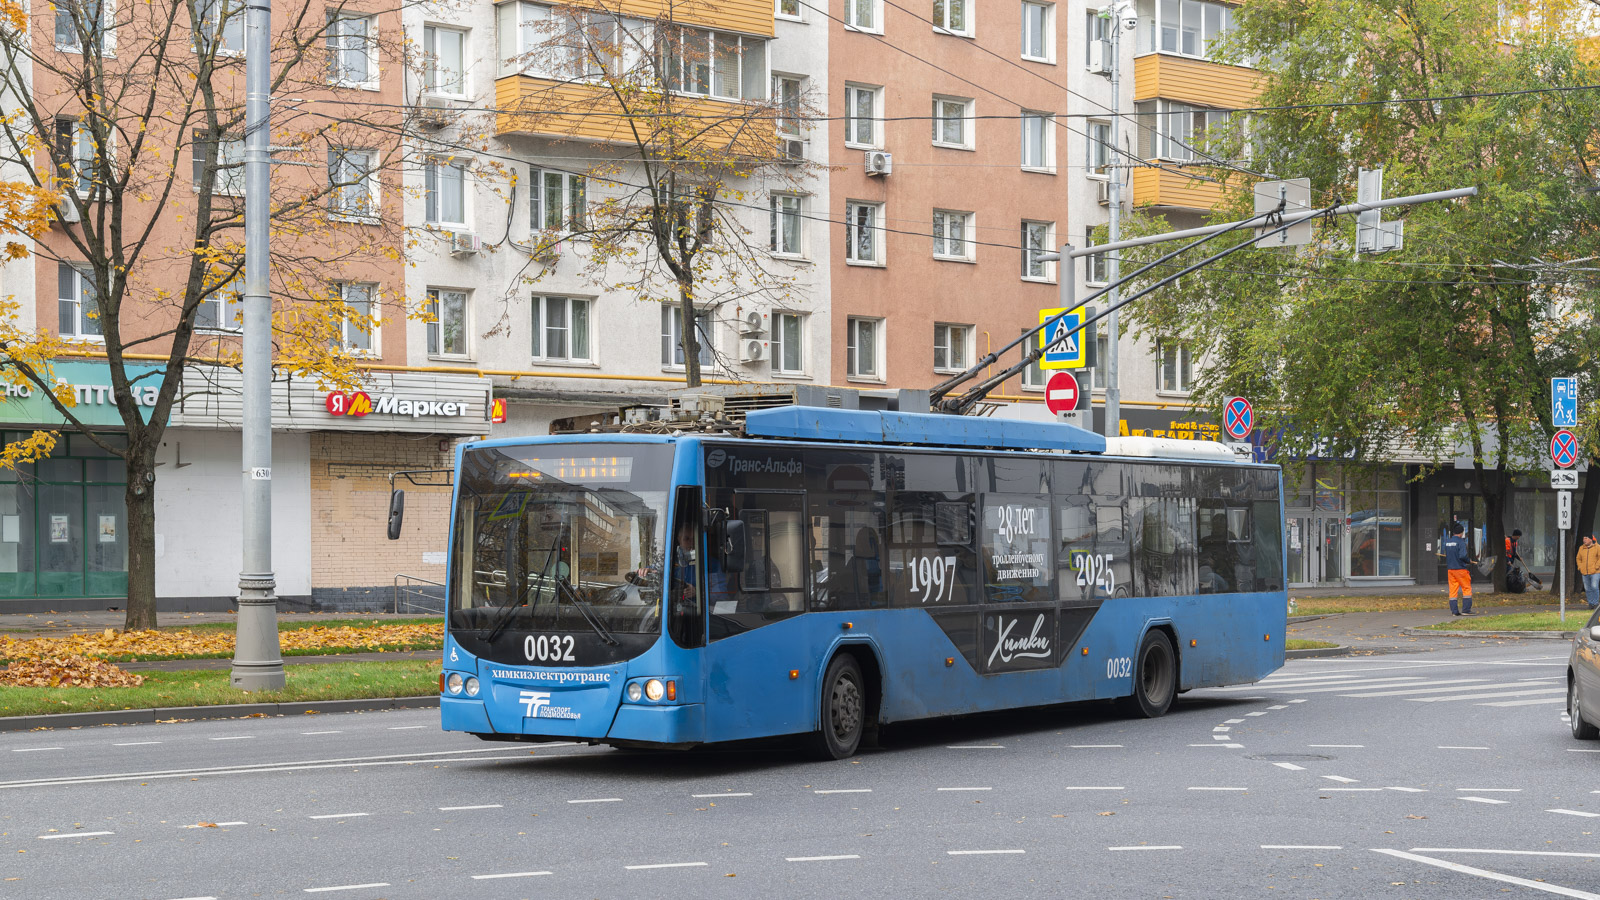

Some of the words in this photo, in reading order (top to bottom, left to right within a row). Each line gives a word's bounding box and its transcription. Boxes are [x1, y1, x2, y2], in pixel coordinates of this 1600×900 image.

[375, 397, 470, 418] Маркет
[728, 455, 803, 477] Транс-Альфа
[1561, 510, 1568, 518] 10
[909, 556, 957, 603] 1997
[997, 569, 1039, 580] движению
[1076, 554, 1115, 595] 2025
[524, 635, 576, 661] 0032
[987, 613, 1052, 670] Химки
[491, 669, 611, 684] химкиэлектротранс
[1106, 657, 1132, 679] 0032
